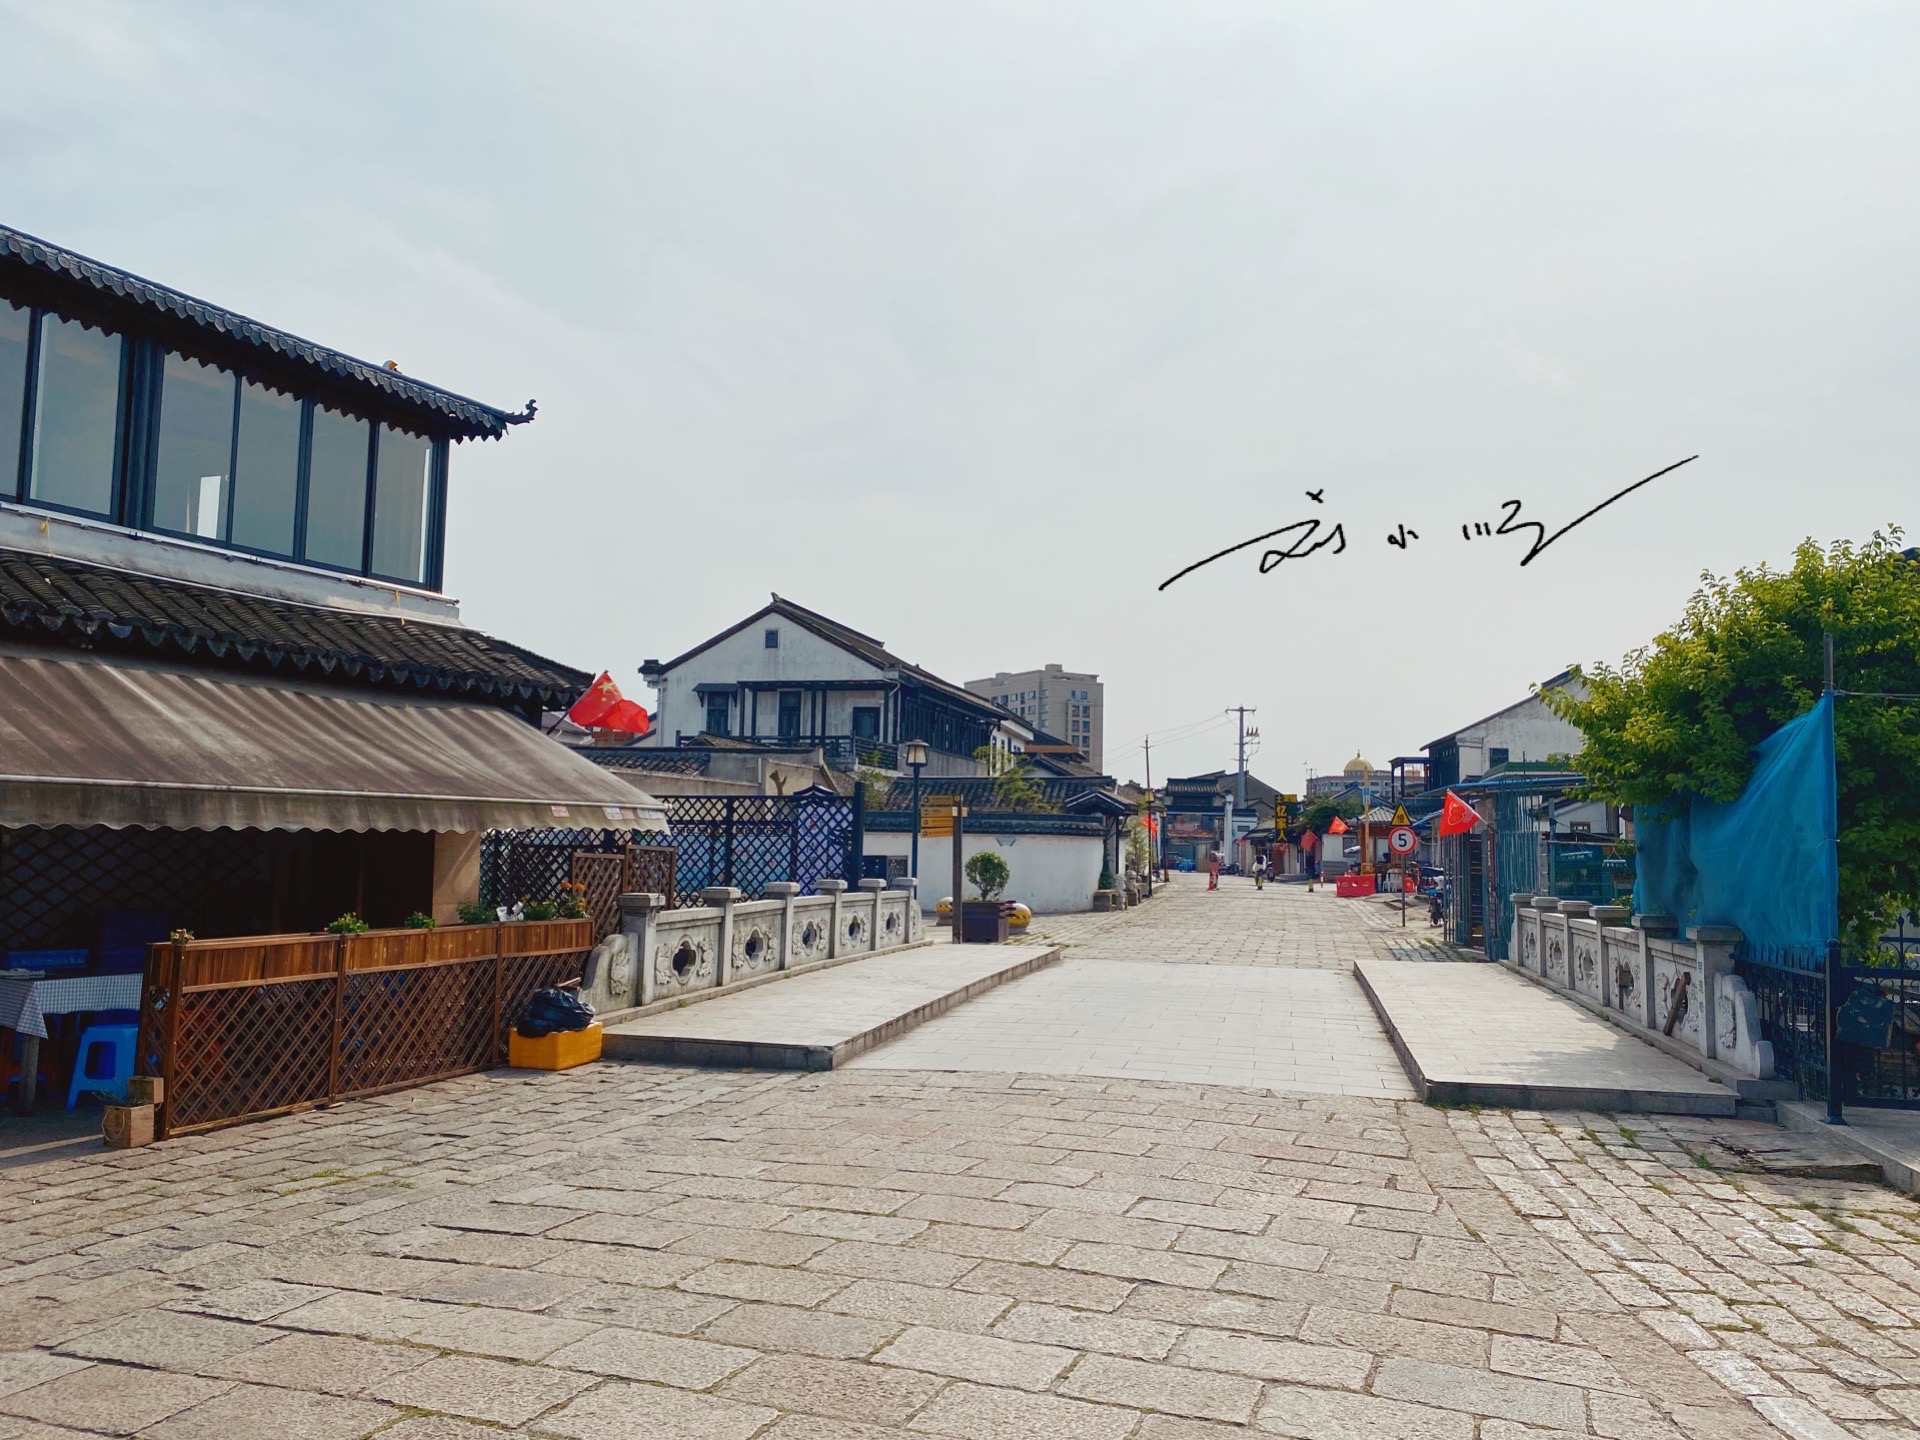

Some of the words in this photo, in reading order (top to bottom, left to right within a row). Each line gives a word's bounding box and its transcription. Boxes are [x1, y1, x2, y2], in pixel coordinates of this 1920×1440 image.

[1276, 805, 1288, 842] 忆家人
[1396, 814, 1405, 823] 慢
[1398, 833, 1407, 848] 5
